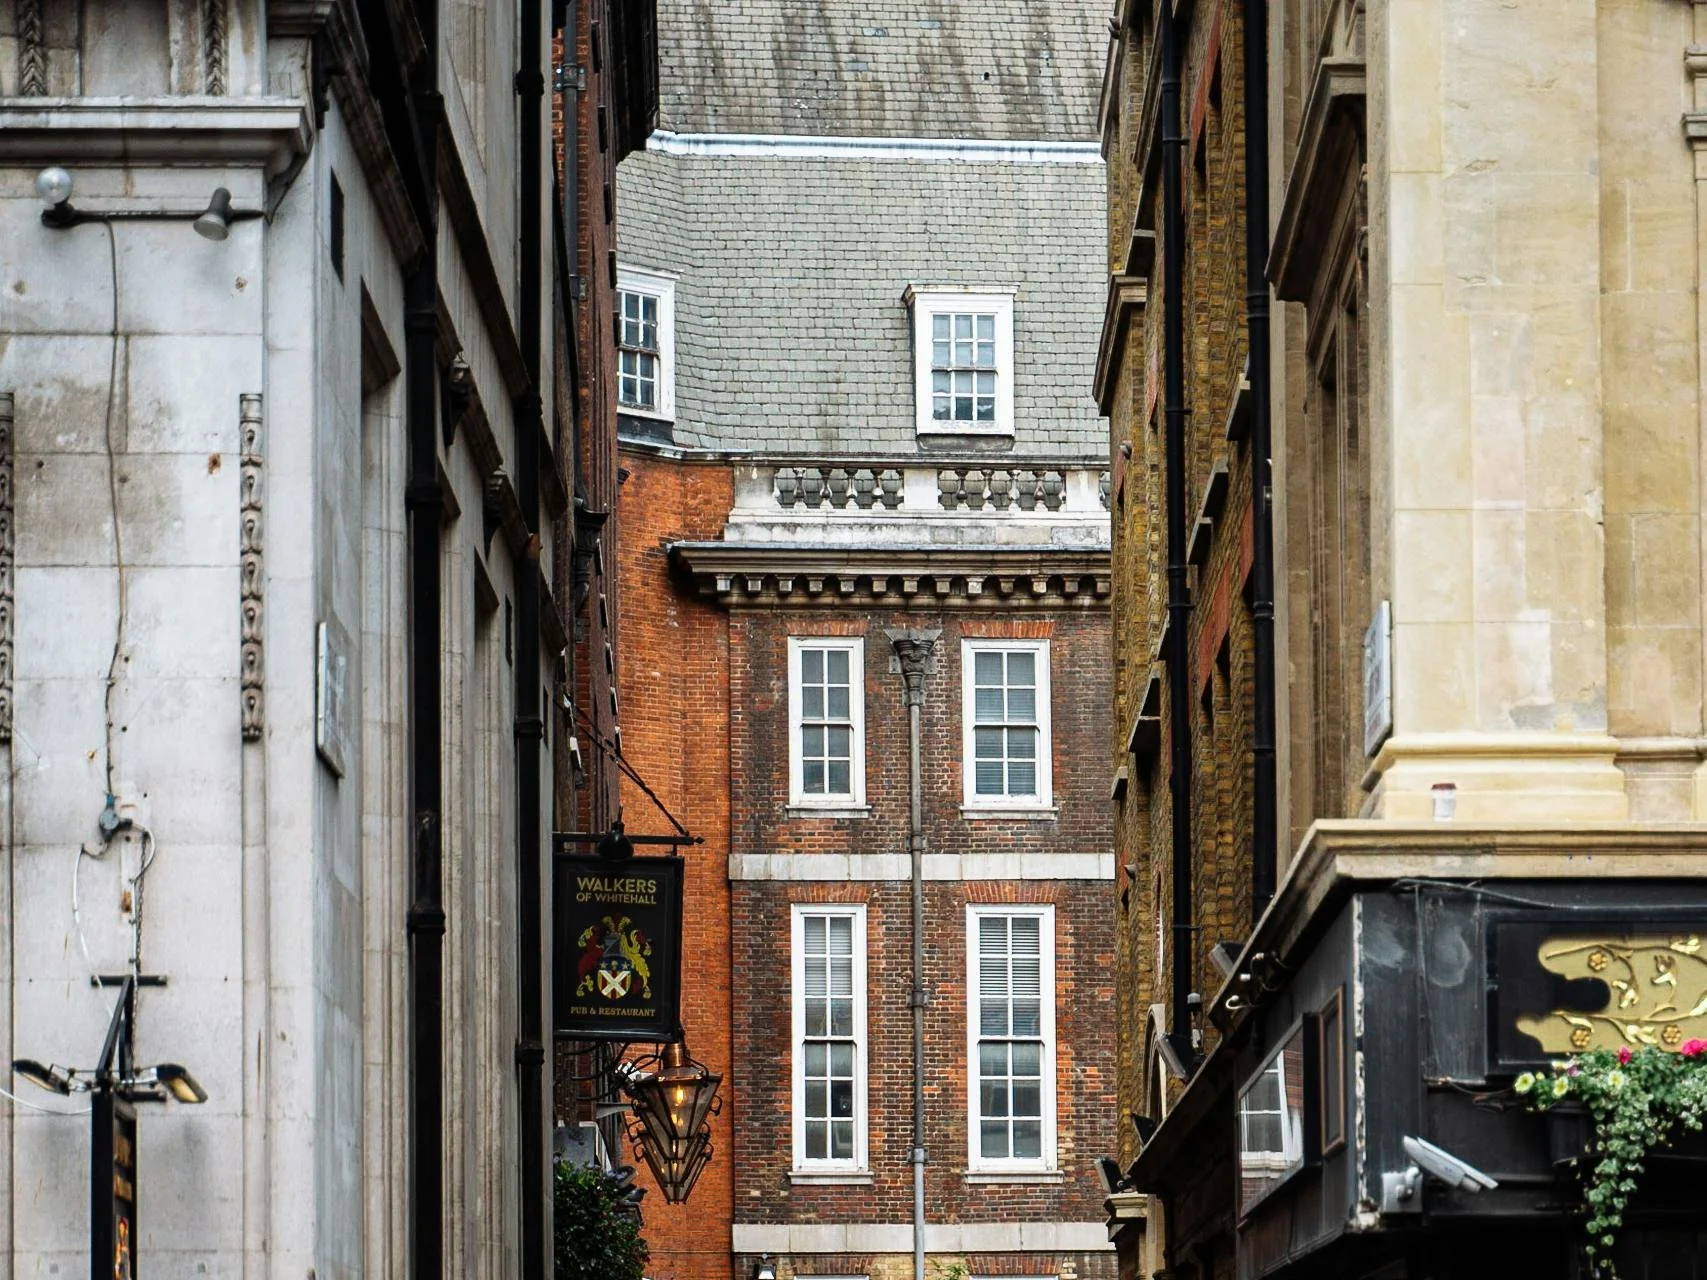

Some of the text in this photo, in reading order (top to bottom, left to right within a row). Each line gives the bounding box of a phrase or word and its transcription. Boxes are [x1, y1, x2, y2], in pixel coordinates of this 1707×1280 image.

[577, 877, 657, 893] WALKERS
[576, 892, 657, 905] OF WHITEHALL
[570, 1006, 588, 1015] PUB
[599, 1007, 656, 1017] RESTAURANT
